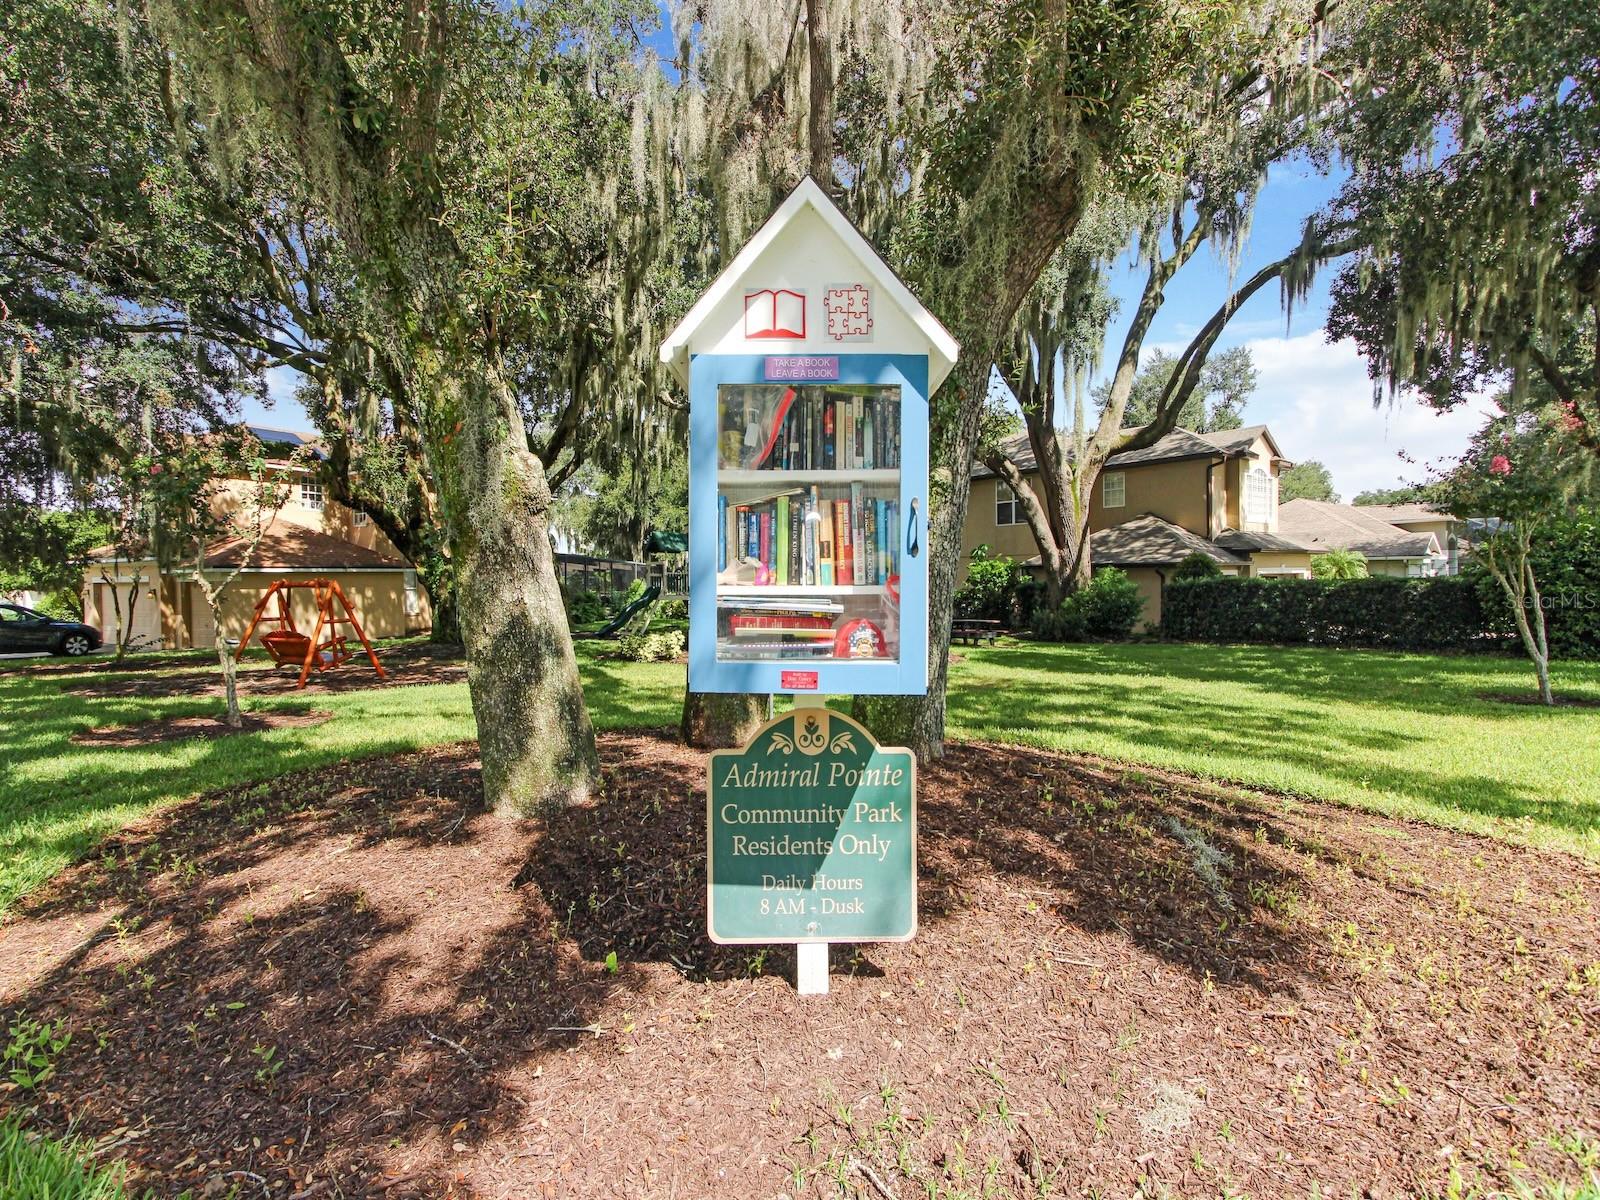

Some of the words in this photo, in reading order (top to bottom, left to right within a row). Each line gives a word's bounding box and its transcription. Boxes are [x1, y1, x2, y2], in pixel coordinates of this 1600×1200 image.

[771, 369, 799, 378] LEAVE
[800, 369, 807, 377] A
[808, 369, 833, 377] BOOK
[774, 359, 796, 367] TAKE
[797, 359, 804, 367] A
[805, 359, 830, 367] BOOK
[721, 762, 820, 788] Admiral
[828, 762, 903, 787] Pointe
[720, 803, 848, 830] Community
[854, 802, 903, 823] Park
[732, 835, 833, 857] Residents
[838, 834, 891, 862] Only
[761, 874, 807, 896] Daily
[811, 874, 863, 891] Hours
[759, 899, 770, 915] 8
[774, 899, 806, 915] AM
[821, 898, 865, 914] Dusk
